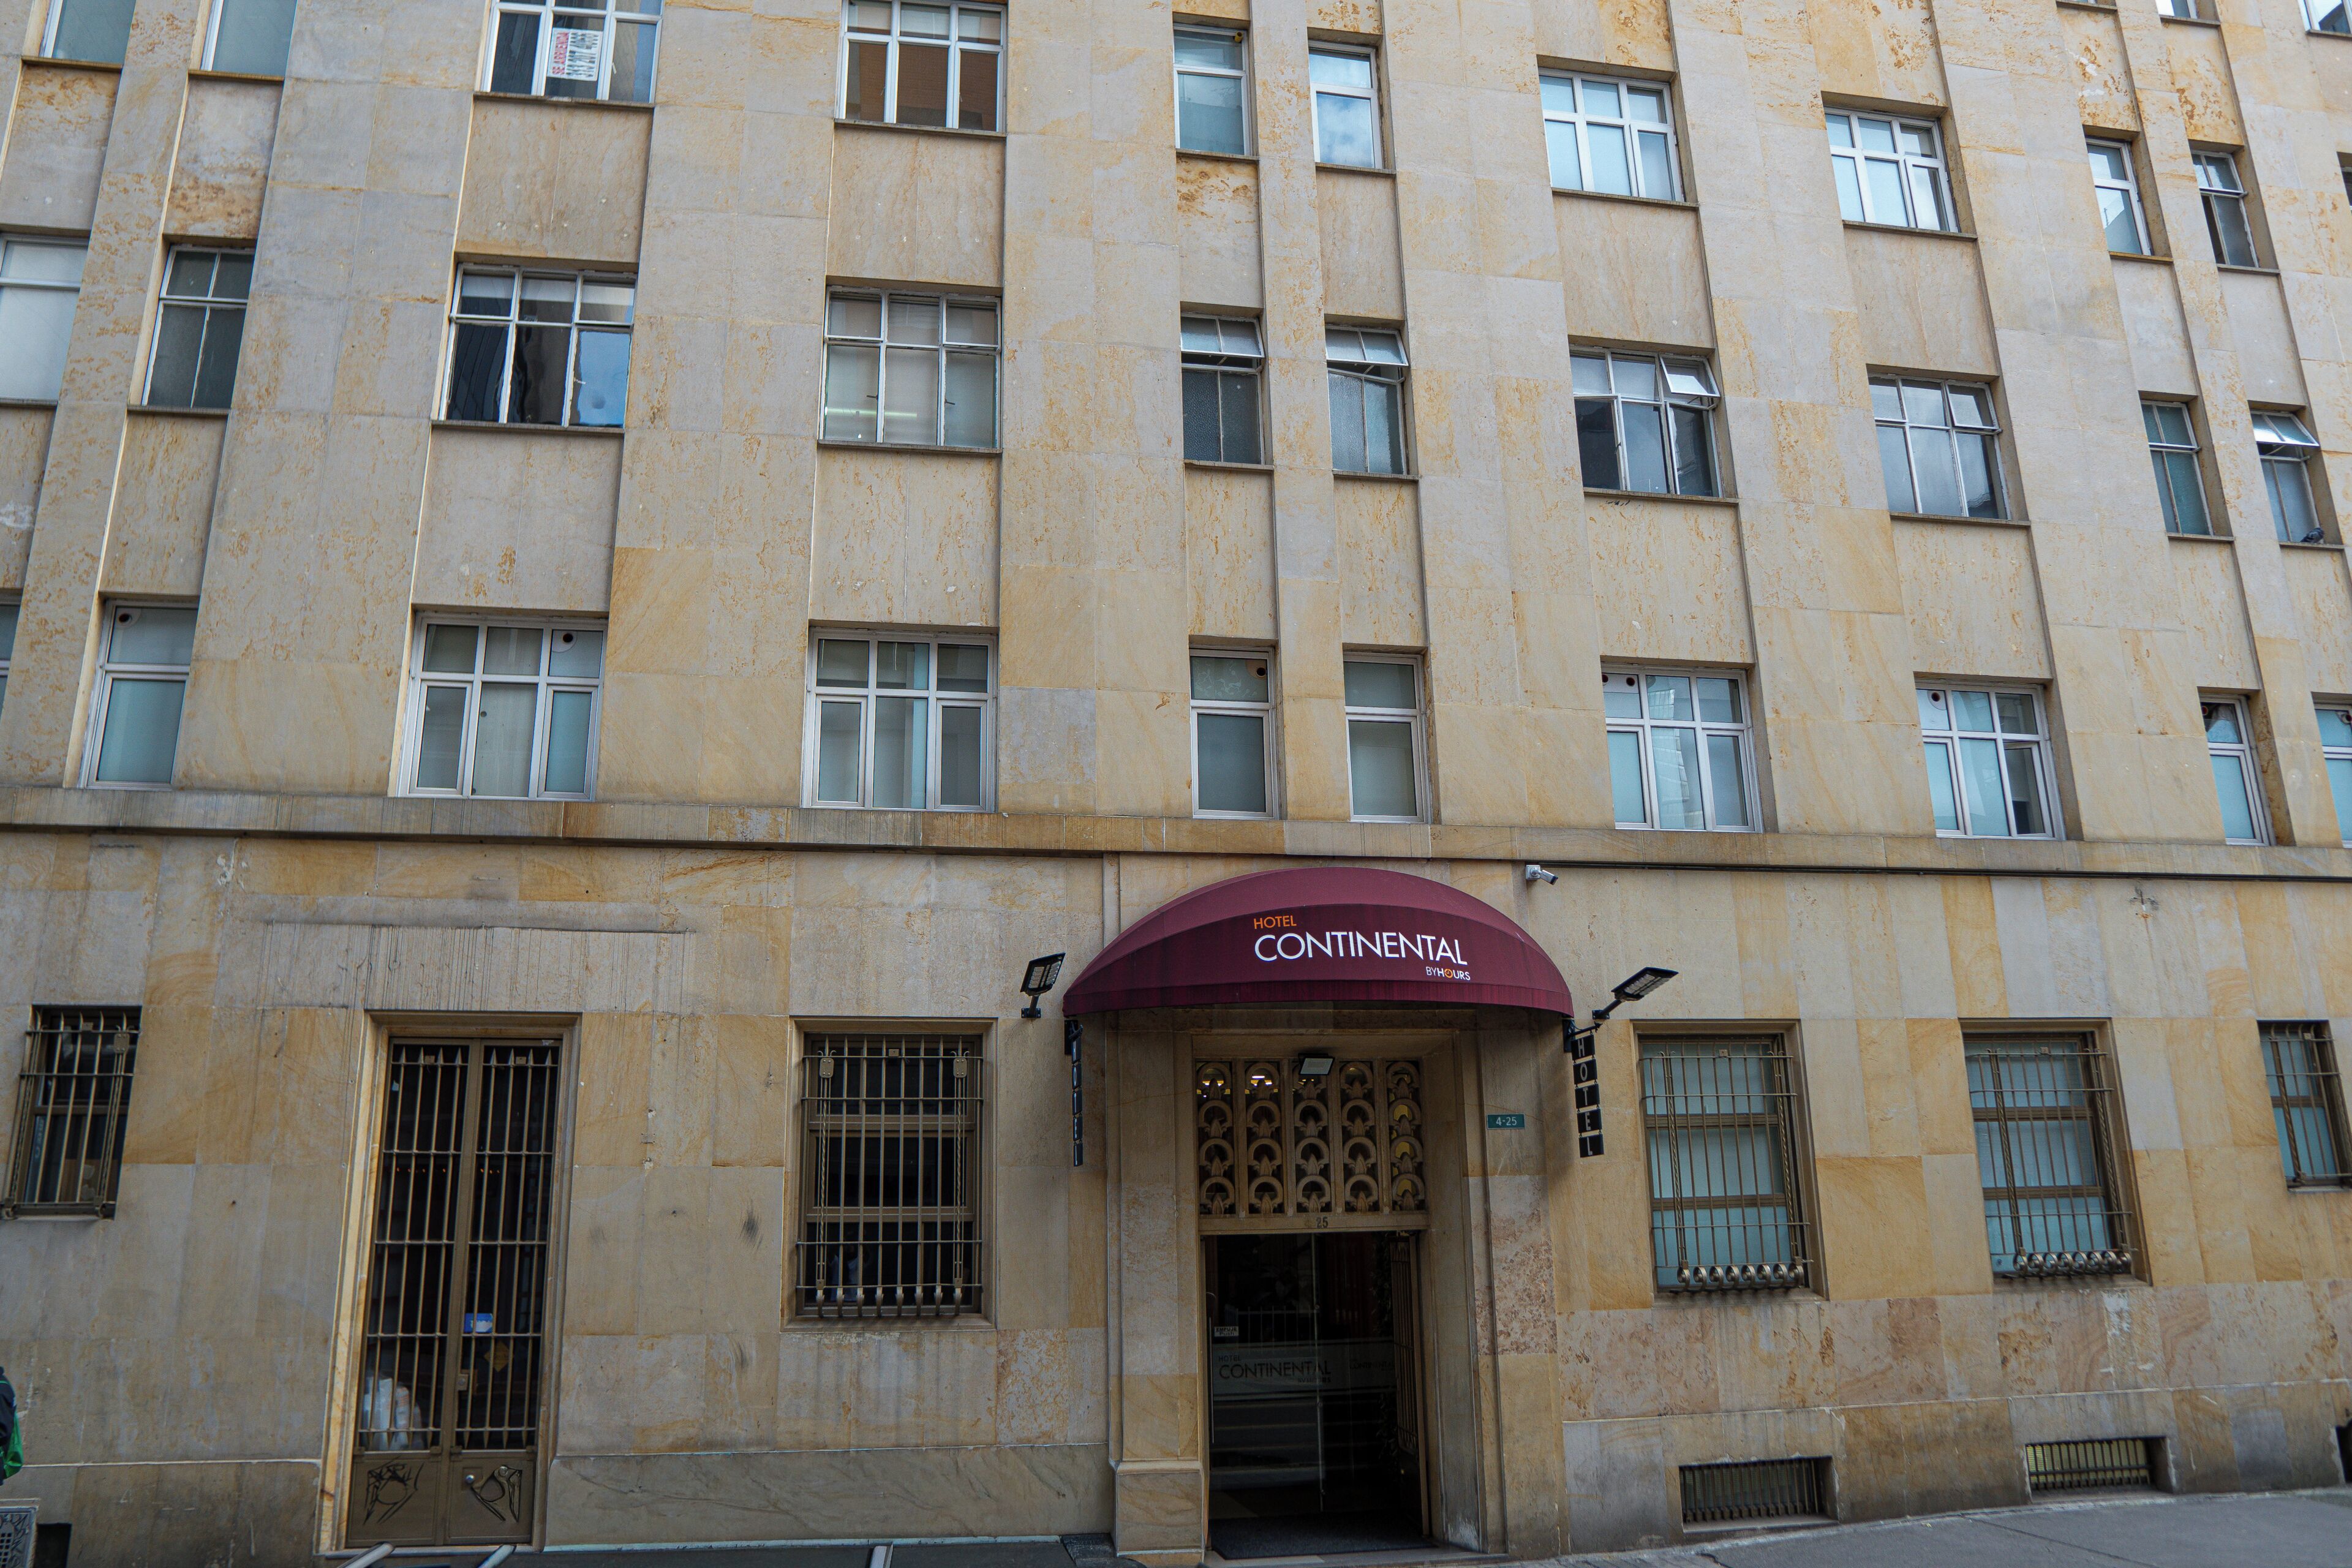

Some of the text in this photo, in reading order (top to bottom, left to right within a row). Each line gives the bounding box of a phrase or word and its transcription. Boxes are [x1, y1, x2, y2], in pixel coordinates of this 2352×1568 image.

[552, 32, 569, 75] SE ARRIENDA
[1254, 915, 1297, 929] HOTEL
[1254, 931, 1468, 965] CONTINENTAL
[1426, 966, 1471, 981] BYHOURS
[1578, 1038, 1593, 1156] HOTEL
[1496, 1117, 1517, 1126] 4-25
[1219, 1360, 1332, 1379] CONTINENTAL
